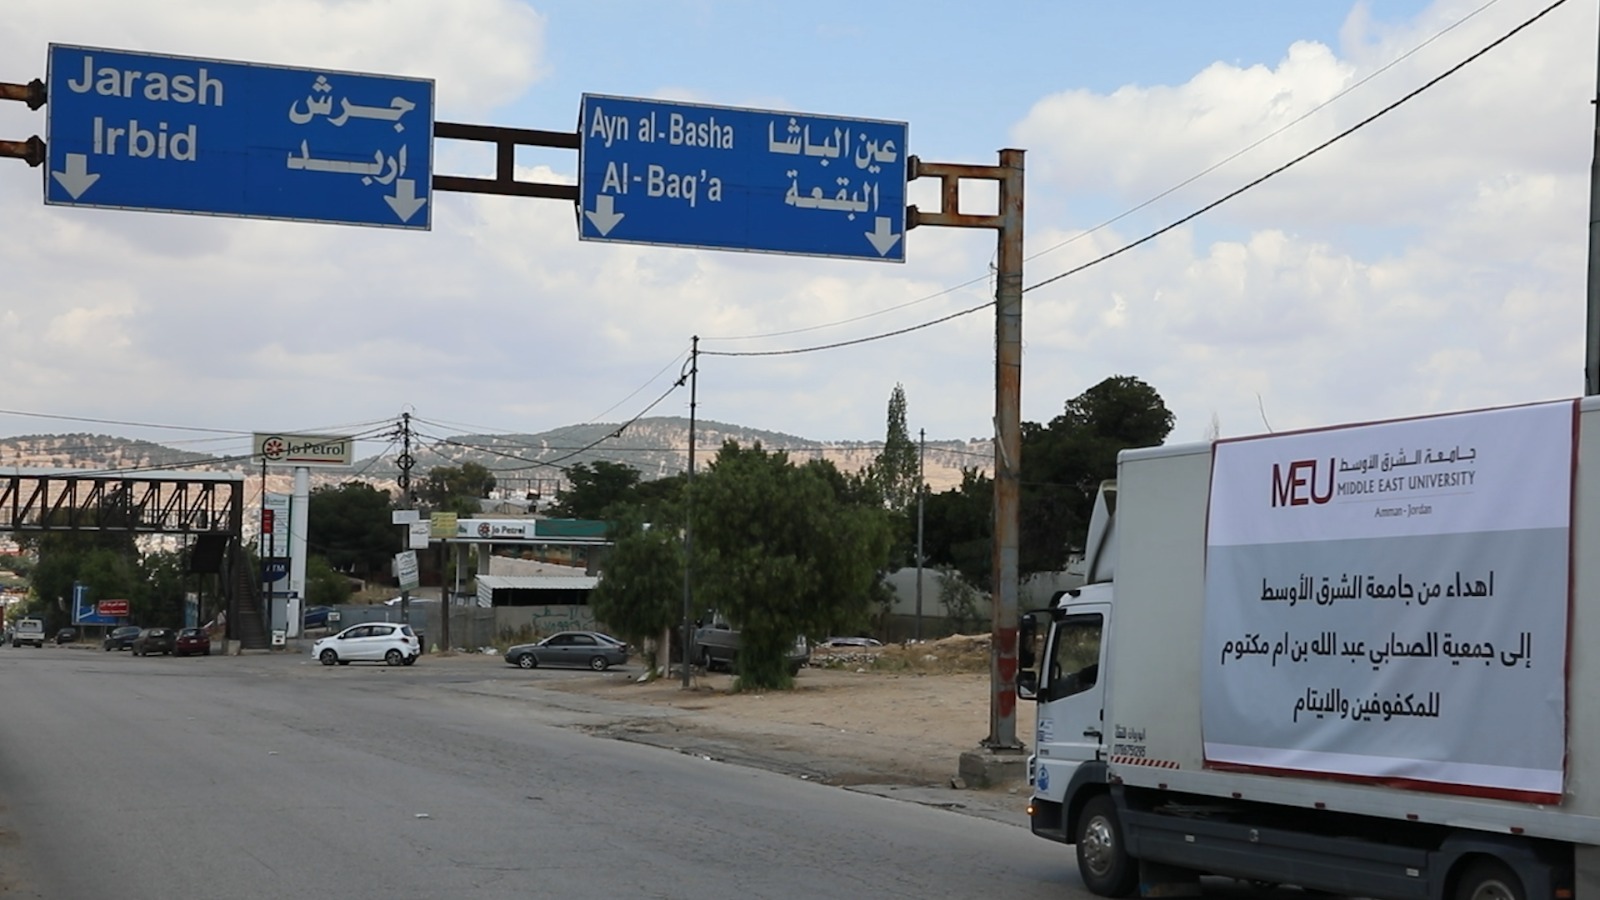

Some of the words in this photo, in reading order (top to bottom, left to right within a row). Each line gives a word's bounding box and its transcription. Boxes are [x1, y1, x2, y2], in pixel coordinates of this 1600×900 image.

[67, 56, 224, 107] Jarash
[288, 75, 416, 132] جرش
[92, 116, 197, 161] Irbid
[590, 106, 628, 148] Ayn
[768, 117, 850, 167] الباشا
[286, 139, 407, 185] اربد
[855, 132, 897, 174] عين
[784, 169, 879, 221] البقعة
[304, 442, 345, 455] Petrol
[1381, 447, 1421, 472] الشرق
[1424, 445, 1476, 465] جامعة
[1271, 457, 1335, 508] MEU
[1337, 480, 1374, 496] MIDDLE
[1379, 477, 1405, 492] EAST
[1408, 471, 1476, 490] UNIVERSITY
[501, 525, 526, 534] Petrol
[1260, 573, 1313, 606] الأوسط
[1316, 573, 1362, 606] الشرق
[1366, 573, 1414, 606] جامعة
[1417, 580, 1441, 606] من
[1446, 570, 1494, 598] اهداء
[1221, 633, 1269, 665] مكتوم
[1272, 631, 1288, 667] ام
[1291, 640, 1308, 662] بن
[1311, 631, 1336, 656] الله
[1340, 641, 1365, 663] عبد
[1369, 631, 1438, 671] الصحابي
[1442, 633, 1495, 666] جمعية
[1501, 632, 1531, 668] إلى
[1293, 687, 1349, 723] والايتام
[1351, 691, 1440, 721] للمكفوفين
